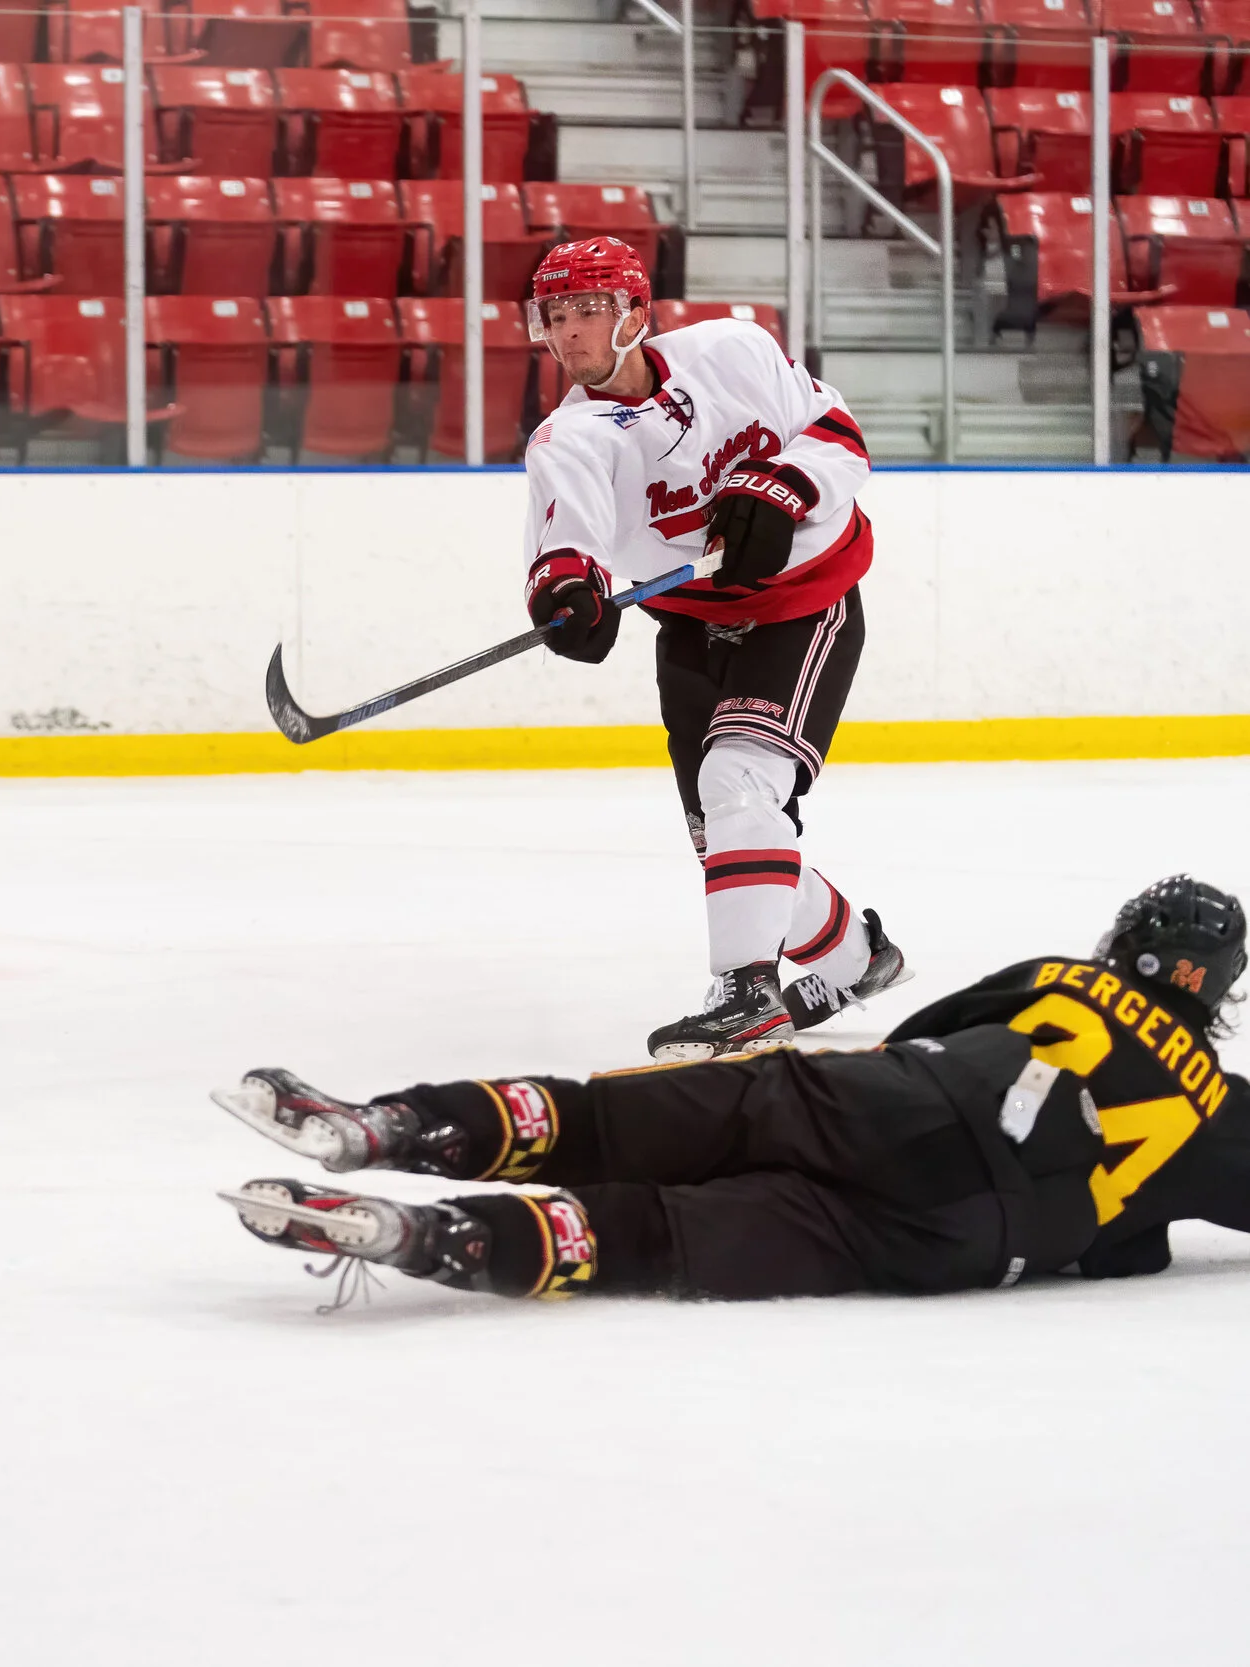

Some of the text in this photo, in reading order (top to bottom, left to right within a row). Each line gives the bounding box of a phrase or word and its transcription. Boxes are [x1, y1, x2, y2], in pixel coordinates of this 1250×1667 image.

[542, 268, 569, 282] TITANS
[646, 480, 699, 518] New
[1033, 962, 1229, 1119] BERGERON
